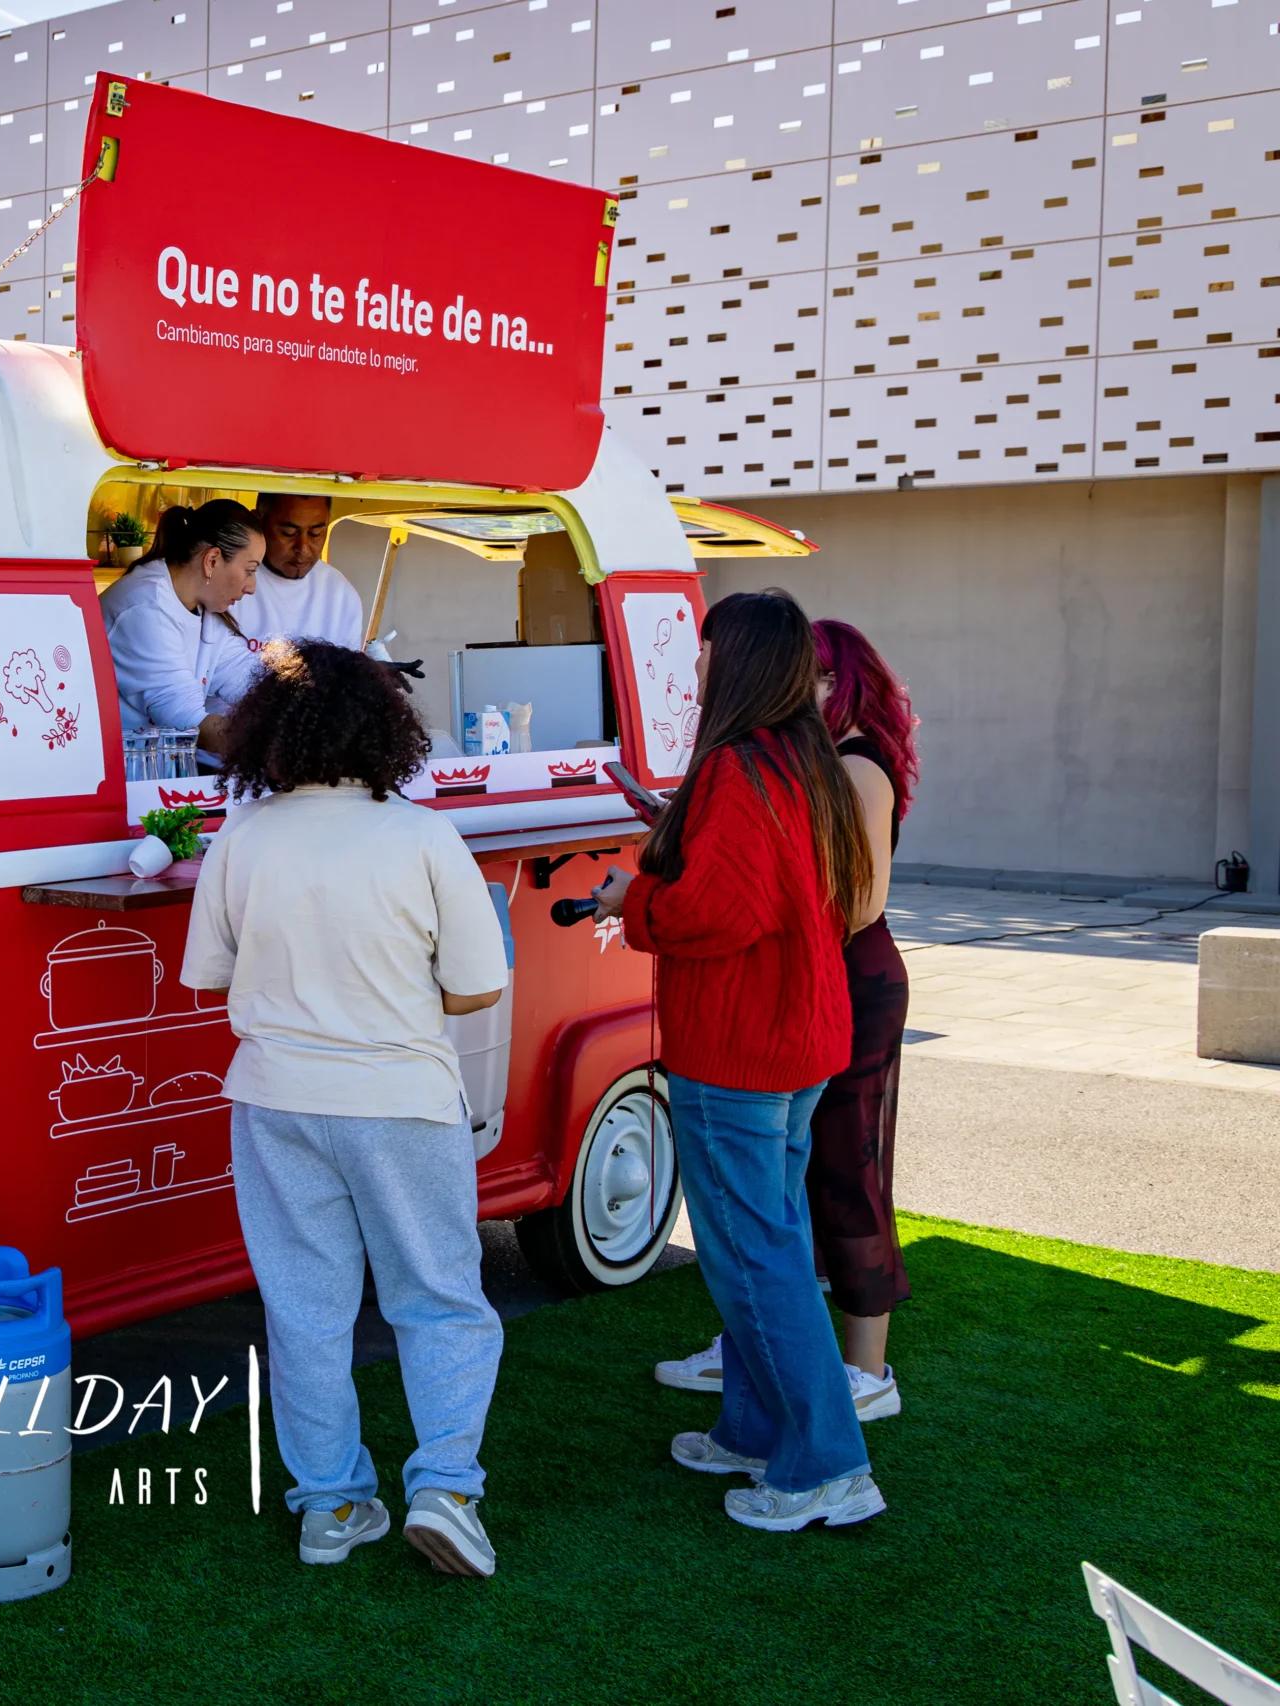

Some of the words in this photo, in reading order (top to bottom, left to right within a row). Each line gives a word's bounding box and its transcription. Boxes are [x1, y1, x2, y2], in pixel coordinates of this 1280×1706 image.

[157, 246, 239, 308] Que
[252, 273, 299, 317] no
[309, 273, 344, 324] te
[354, 277, 434, 337] falte
[442, 294, 482, 344] de
[490, 312, 554, 355] na...
[156, 319, 240, 350] Cambiamos
[243, 336, 273, 355] para
[276, 340, 316, 361] seguir
[318, 341, 367, 366] dandote
[369, 348, 381, 368] lo
[383, 355, 419, 375] mejor.
[8, 1354, 46, 1371] CEPSA
[8, 1370, 40, 1381] PROPANO
